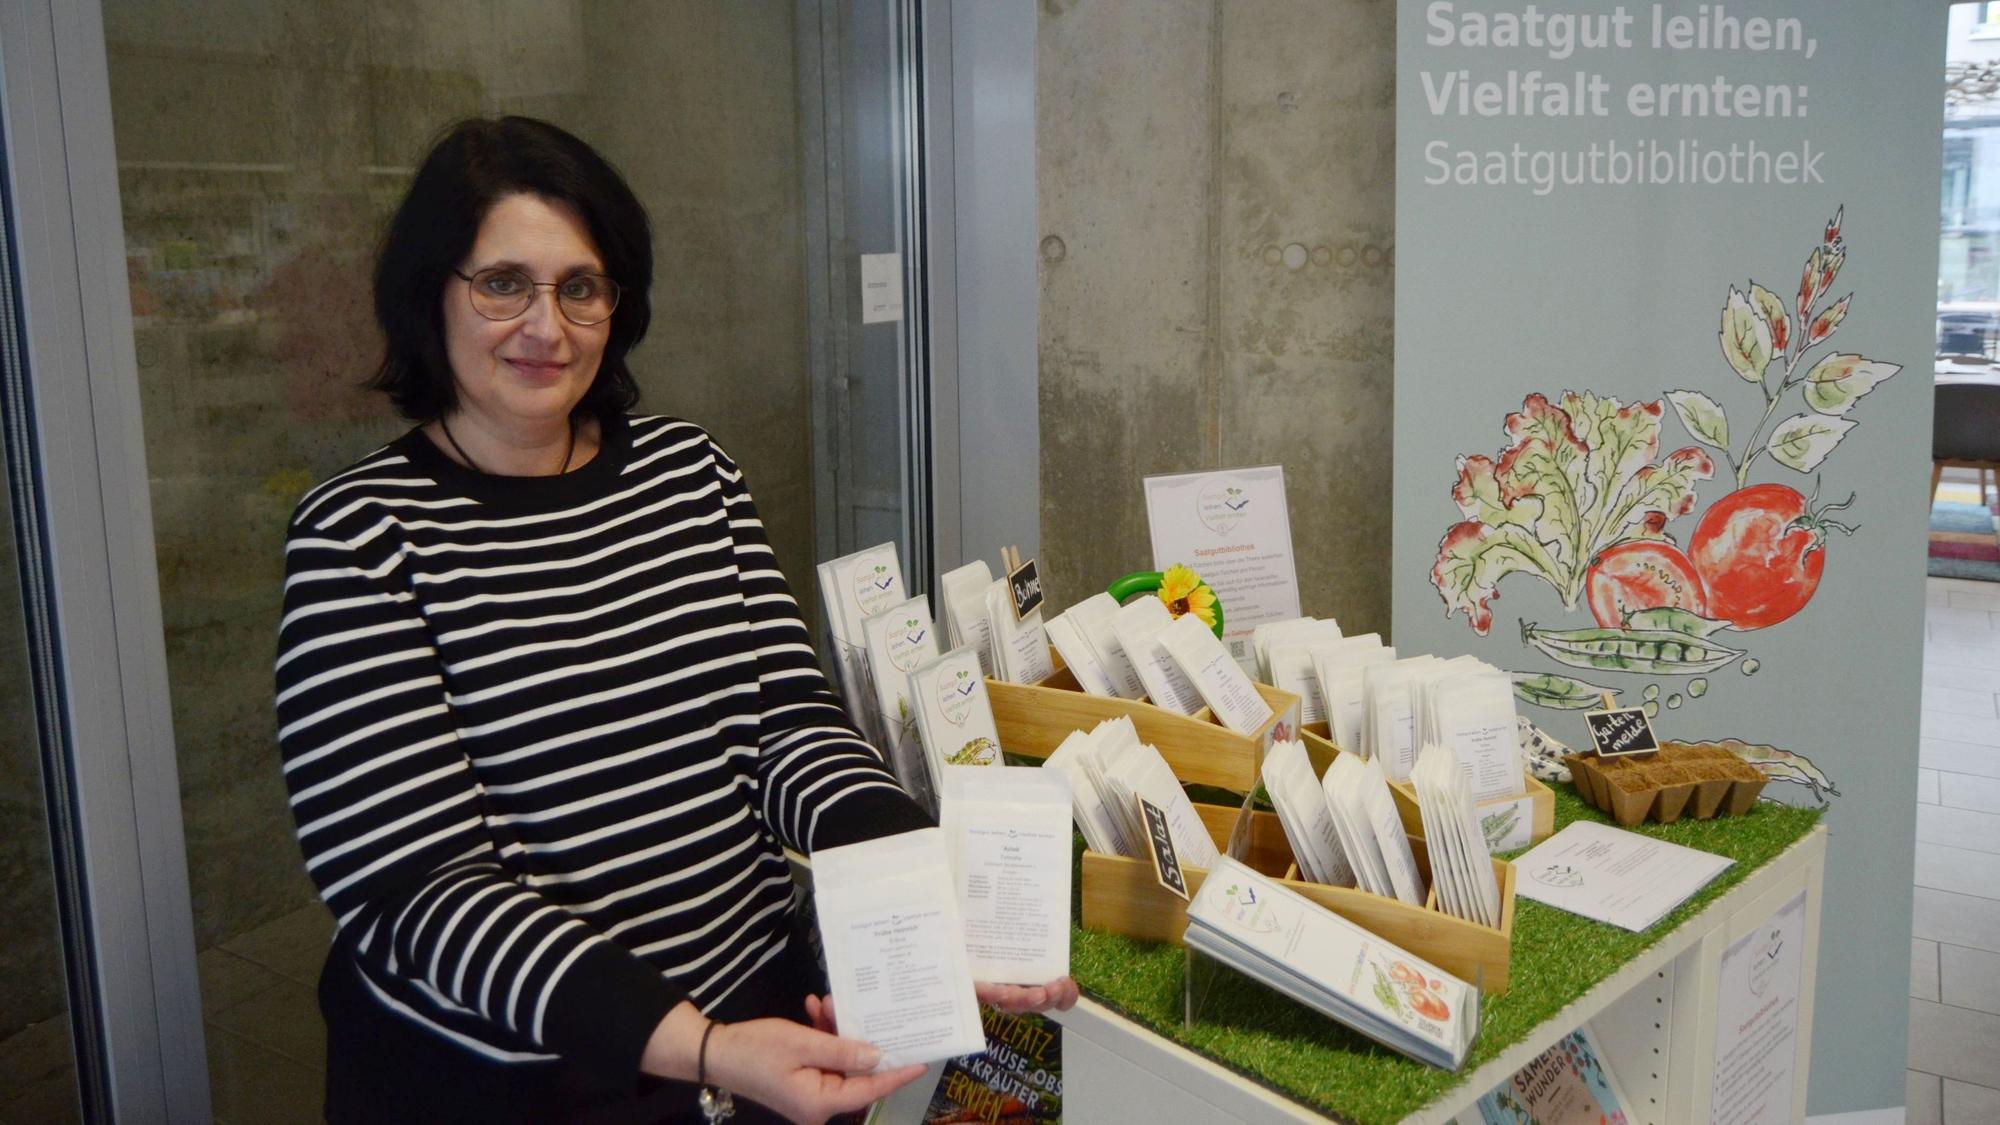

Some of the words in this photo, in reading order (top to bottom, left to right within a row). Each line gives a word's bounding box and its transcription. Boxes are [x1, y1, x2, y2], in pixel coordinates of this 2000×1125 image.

[1425, 0, 1634, 58] Saatgut
[1651, 4, 1818, 59] leihen,
[1420, 70, 1609, 117] Vielfalt
[1626, 75, 1809, 118] ernten:
[1423, 140, 1825, 195] Saatgutbibliothek
[946, 1070, 1004, 1124] ERNTEN
[971, 1057, 1039, 1110] KRÄUTER
[1525, 1055, 1567, 1107] WUNDER
